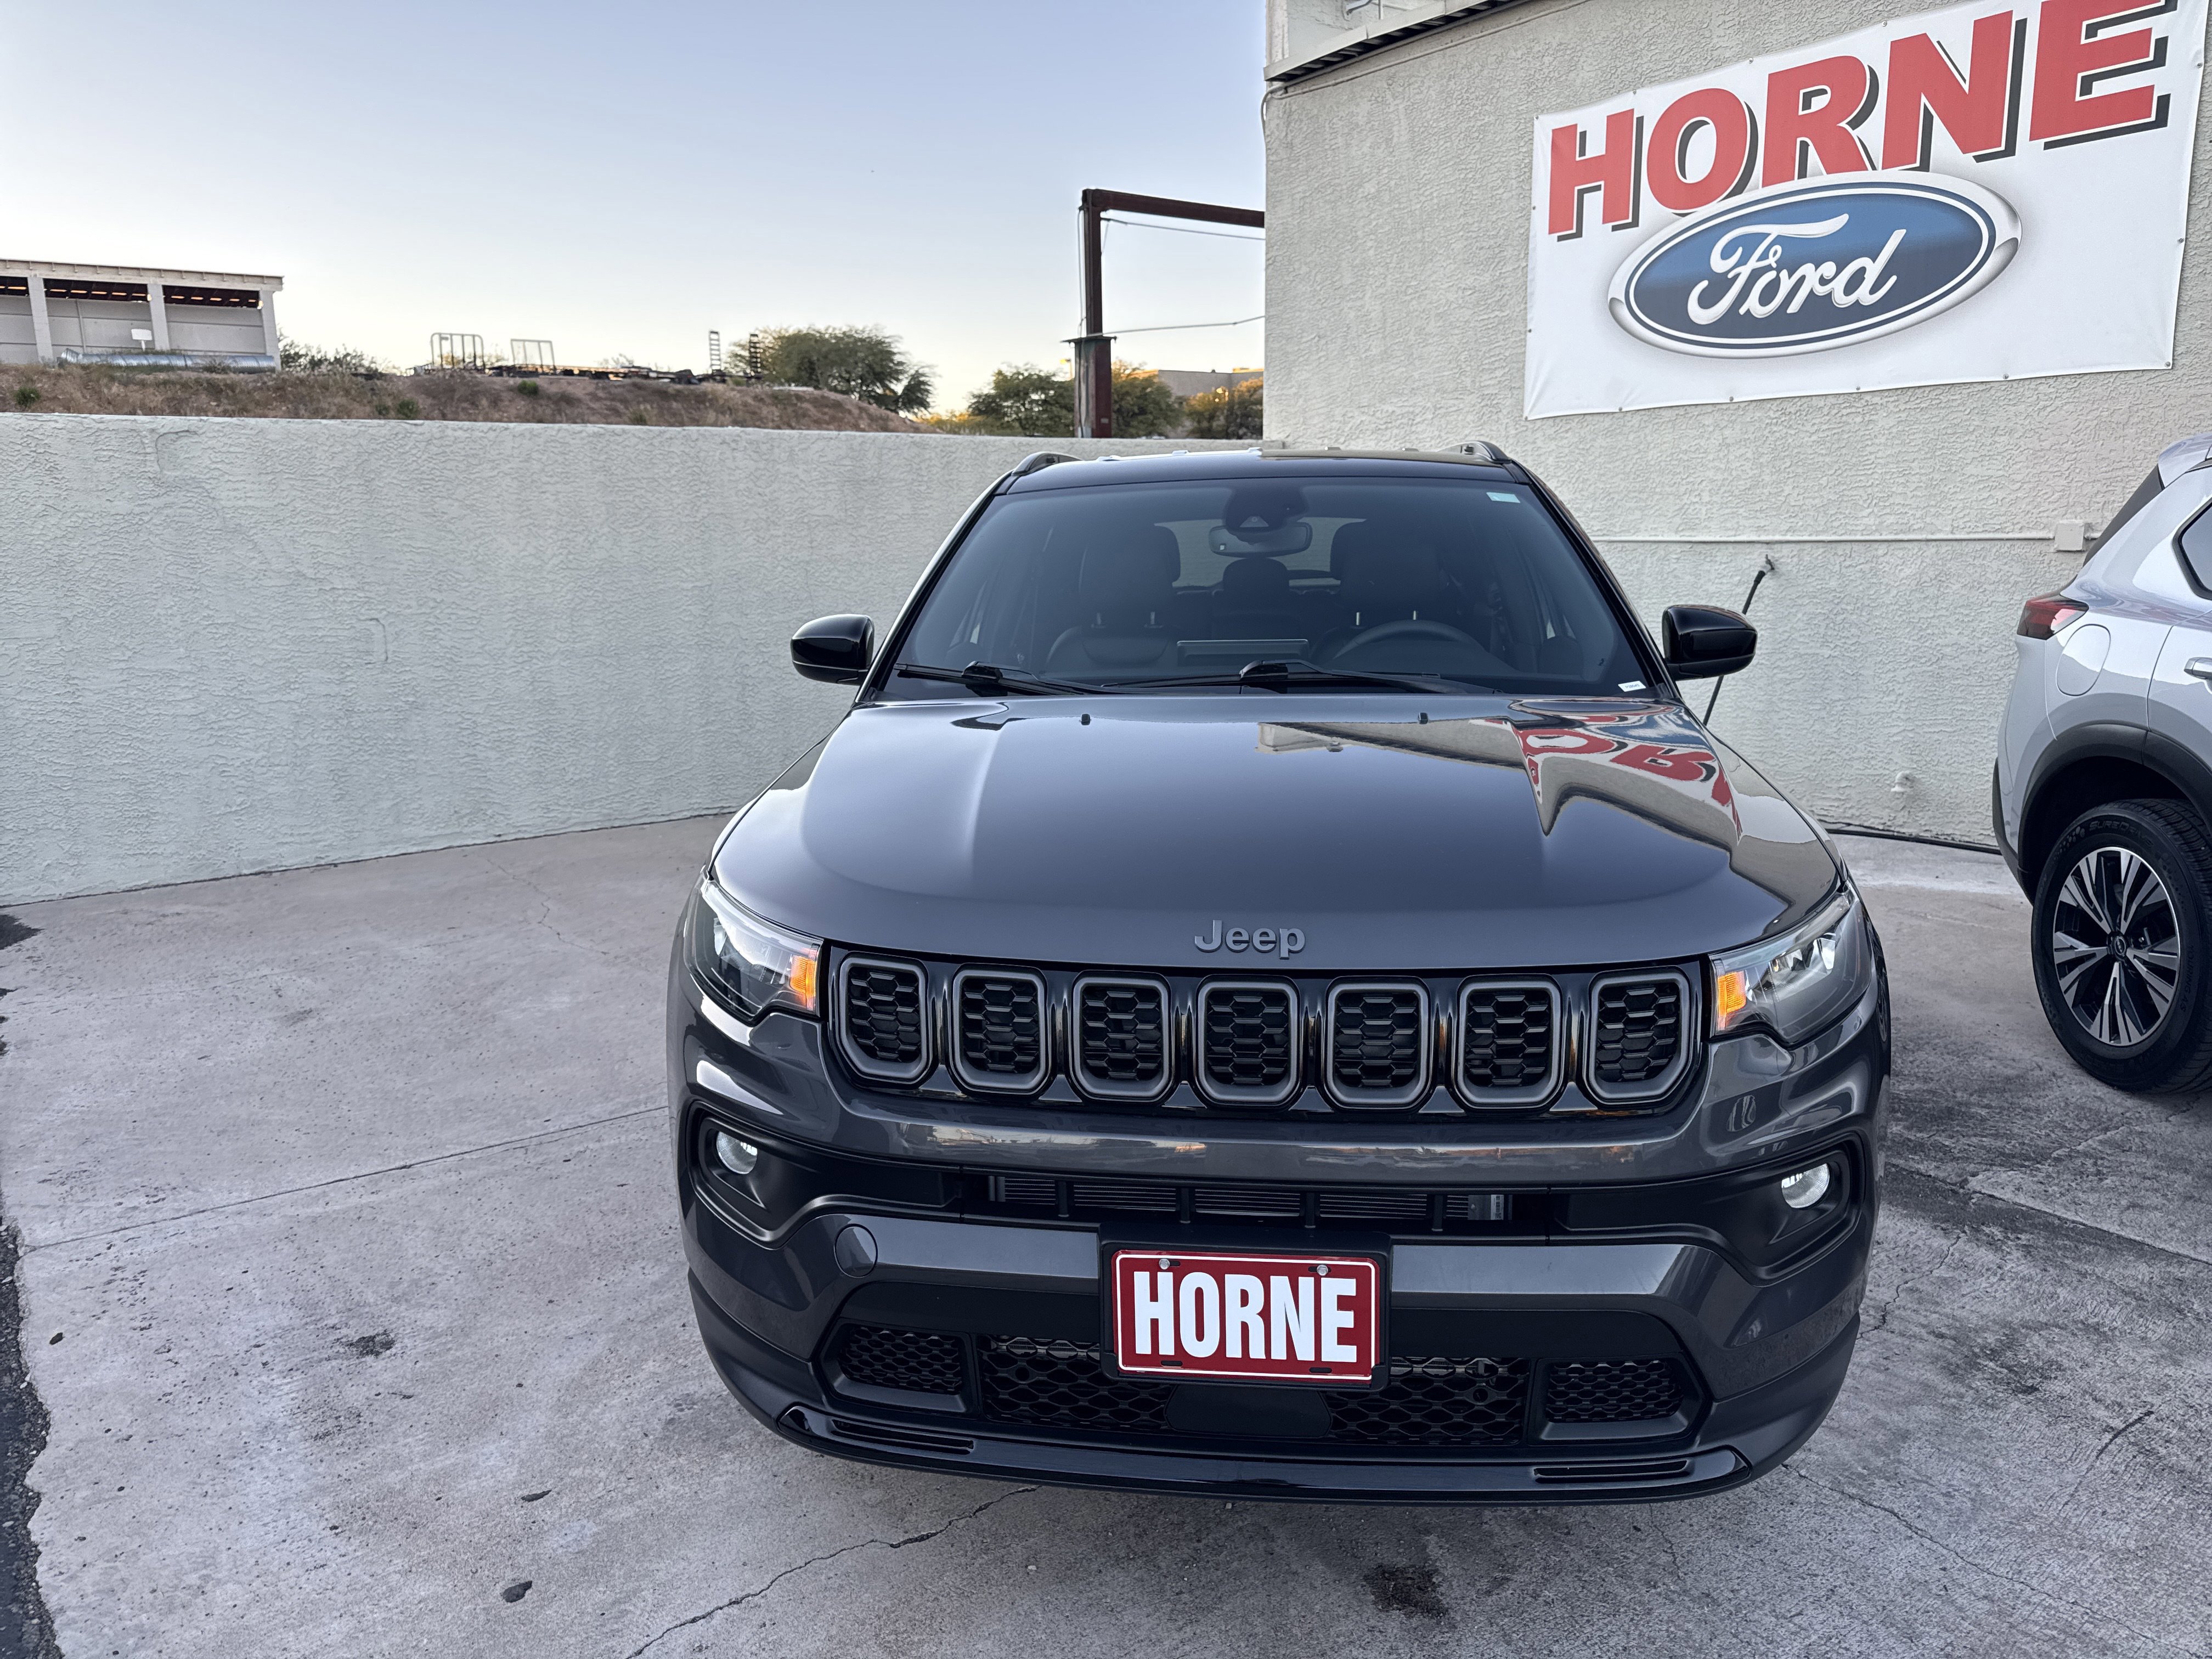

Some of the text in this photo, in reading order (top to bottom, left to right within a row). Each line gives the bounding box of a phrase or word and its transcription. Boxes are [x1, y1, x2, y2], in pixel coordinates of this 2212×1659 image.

[1548, 0, 2177, 240] HORNE
[1687, 213, 1906, 325] Ford
[1194, 920, 1306, 960] Jeep
[1133, 1271, 1358, 1363] HORNE
